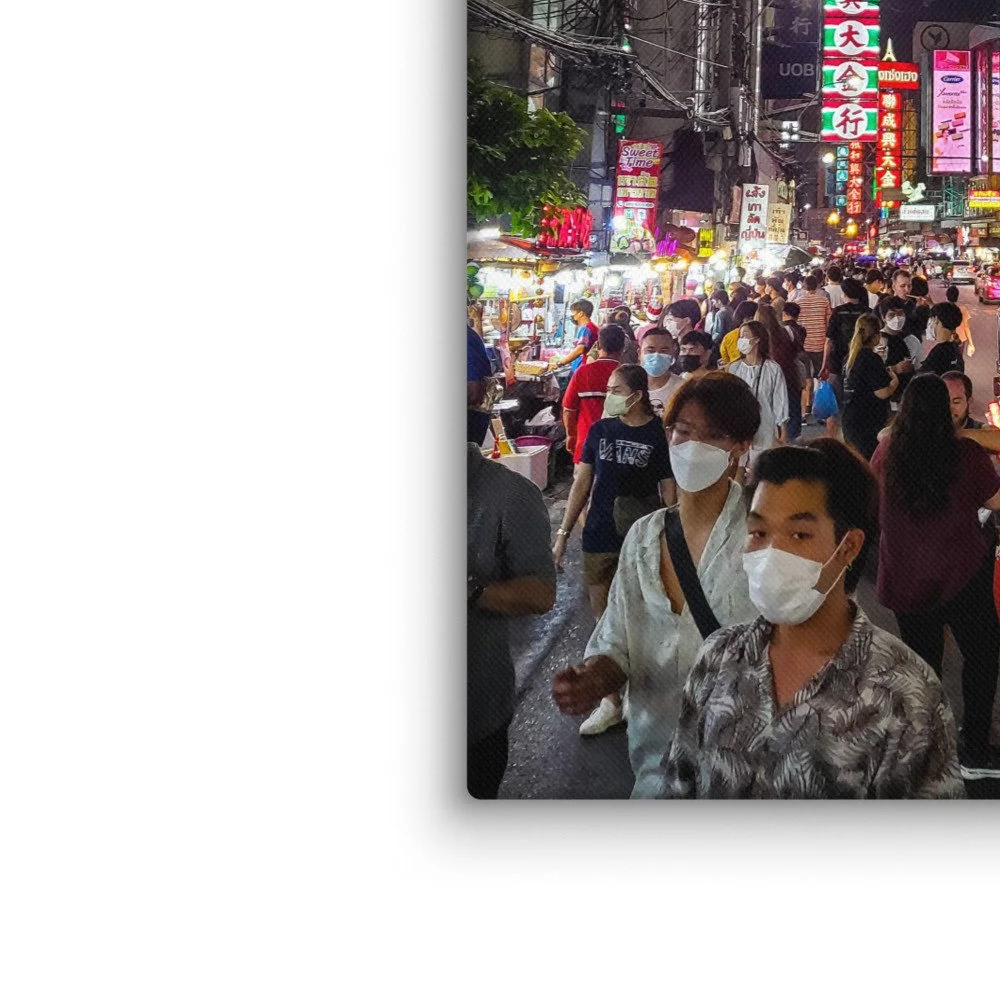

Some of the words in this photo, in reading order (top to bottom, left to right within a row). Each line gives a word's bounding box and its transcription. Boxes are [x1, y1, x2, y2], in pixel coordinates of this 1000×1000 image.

[779, 62, 815, 77] UOB
[621, 146, 658, 159] Sweet
[880, 93, 898, 206] 聯成興大金
[625, 156, 653, 169] Time
[599, 438, 655, 468] VANS
